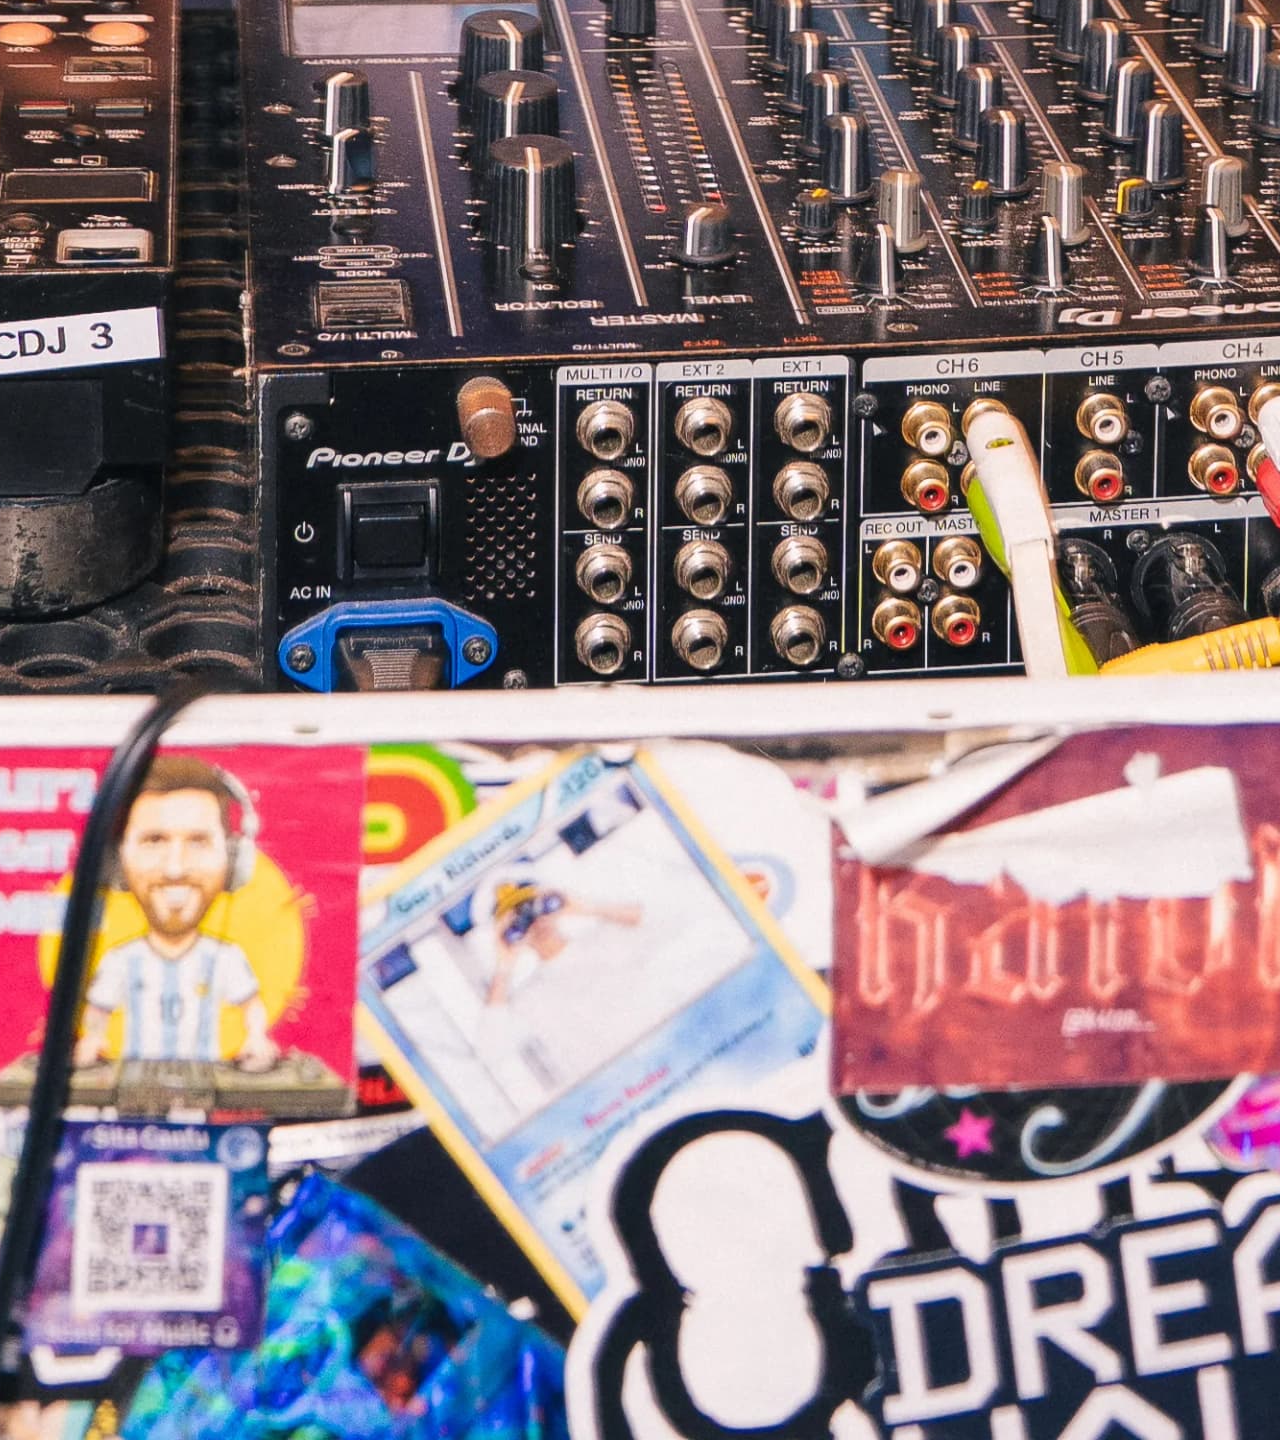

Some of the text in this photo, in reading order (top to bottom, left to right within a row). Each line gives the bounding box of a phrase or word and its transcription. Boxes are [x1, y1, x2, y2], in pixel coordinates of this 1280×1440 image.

[681, 293, 749, 305] LEVEL
[493, 299, 601, 312] ISOLATOR
[588, 312, 702, 327] MASTER
[89, 321, 115, 350] 3
[355, 330, 414, 342] MULTI
[1080, 350, 1124, 367] CH 5
[681, 363, 725, 377] EXT 2
[782, 360, 822, 374] EXT 1
[936, 357, 980, 375] CH 6
[565, 366, 643, 382] MULTI I/O
[1194, 367, 1237, 380] PHONO
[973, 380, 1001, 392] LINE
[1088, 374, 1115, 386] LINE
[675, 384, 731, 397] RETURN
[773, 381, 829, 394] RETURN
[906, 383, 950, 395] PHONO
[1239, 386, 1247, 397] L
[576, 387, 633, 401] RETURN
[1126, 392, 1134, 403] L
[952, 402, 960, 413] L
[737, 439, 744, 450] L
[832, 435, 839, 446] L
[636, 443, 643, 454] L
[306, 447, 436, 468] Pioneer
[1237, 478, 1246, 490] R
[1125, 485, 1133, 496] R
[831, 498, 839, 509] R
[951, 494, 960, 506] R
[635, 507, 644, 518] R
[736, 503, 745, 514] R
[1089, 508, 1159, 523] MASTER 1
[780, 524, 818, 536] SEND
[865, 520, 924, 535] REC OUT
[584, 533, 622, 544] SEND
[682, 528, 721, 540] SEND
[1103, 529, 1113, 540] R
[736, 581, 743, 592] L
[830, 576, 837, 587] L
[289, 586, 331, 599] AC IN
[634, 586, 641, 596] L
[982, 631, 991, 643] R
[829, 641, 838, 651] R
[864, 639, 872, 650] R
[633, 651, 642, 661] R
[734, 646, 744, 656] R
